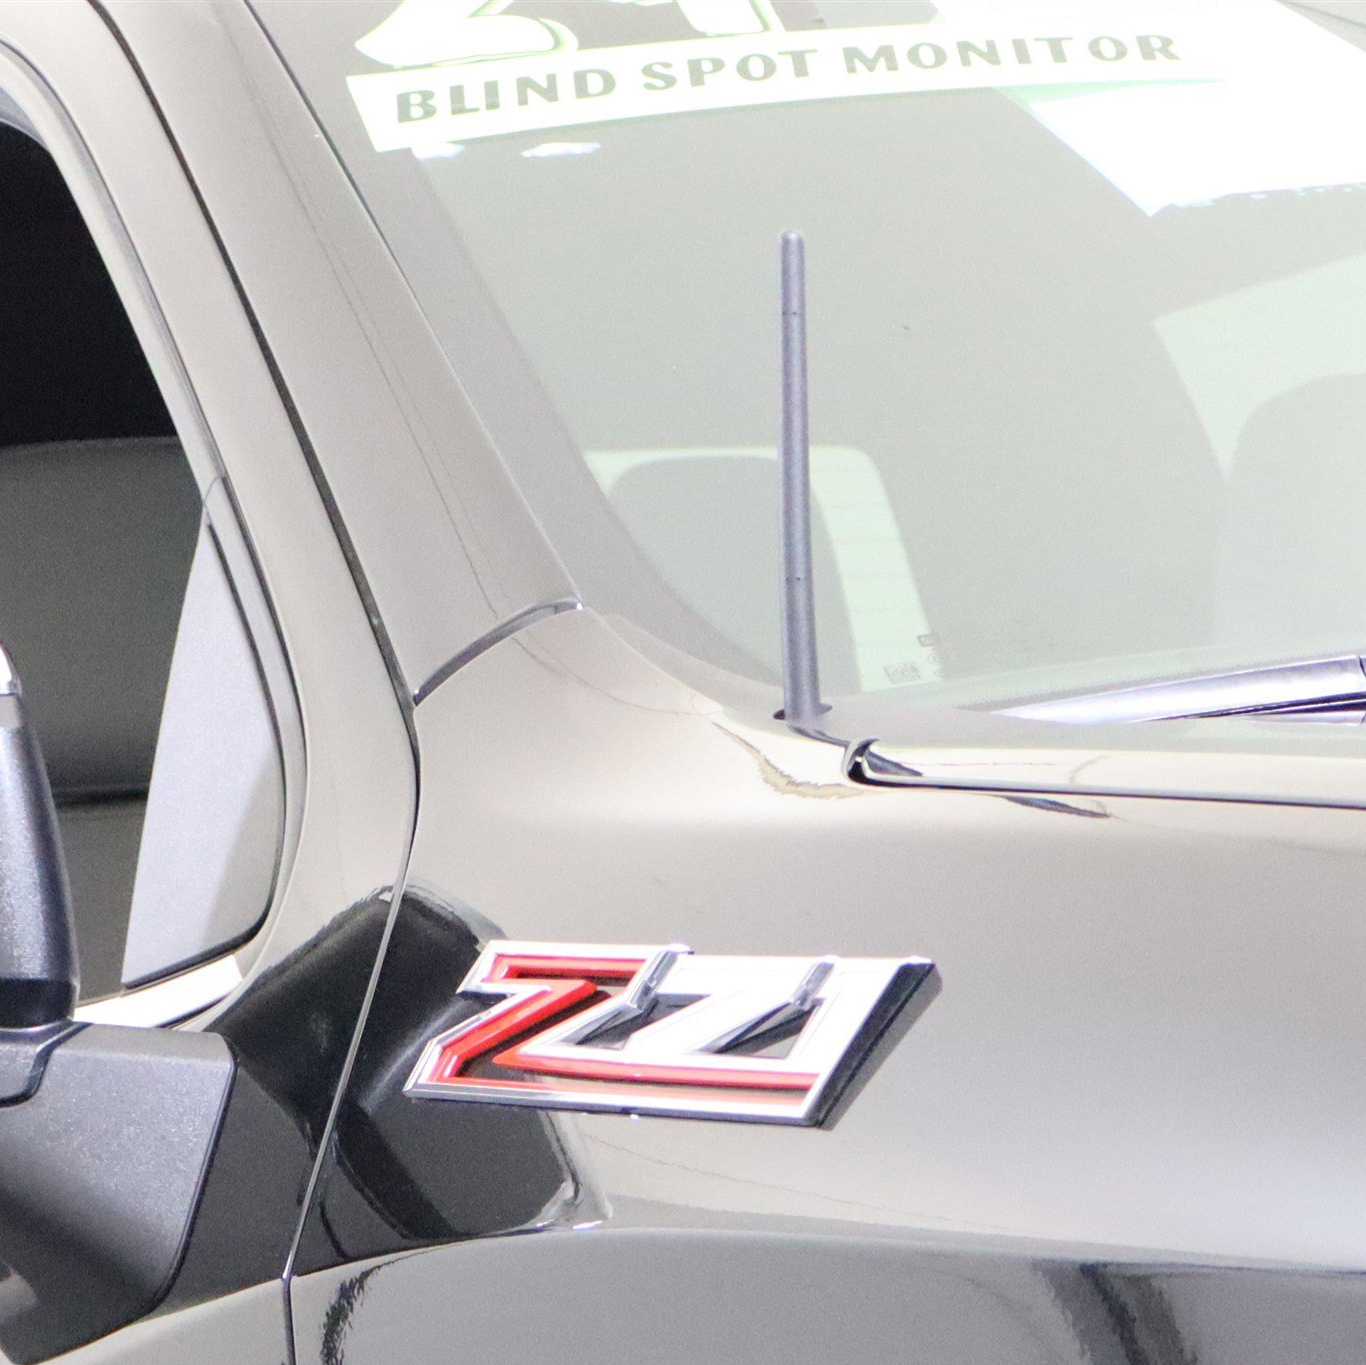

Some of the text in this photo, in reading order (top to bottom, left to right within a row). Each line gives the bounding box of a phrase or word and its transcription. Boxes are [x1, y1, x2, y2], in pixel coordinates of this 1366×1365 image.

[396, 32, 1183, 124] BLIND SPOT MONITOR
[403, 939, 943, 1130] Z71
